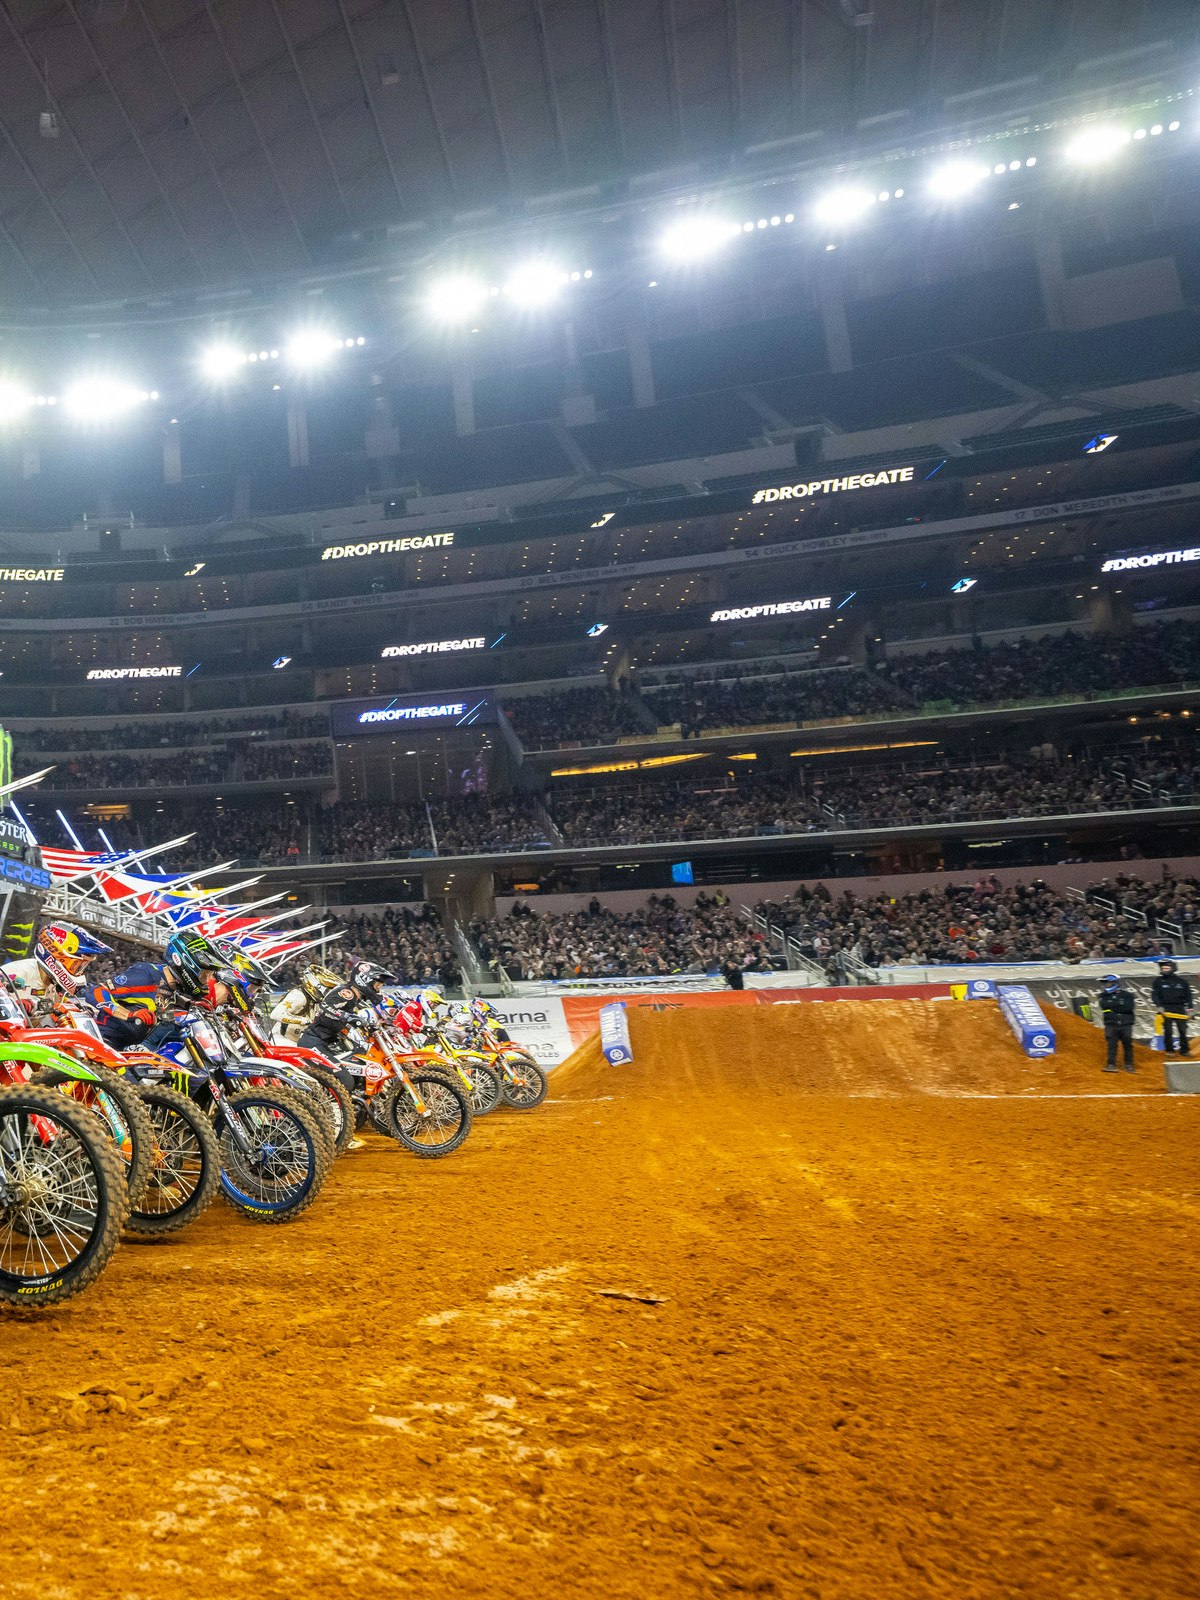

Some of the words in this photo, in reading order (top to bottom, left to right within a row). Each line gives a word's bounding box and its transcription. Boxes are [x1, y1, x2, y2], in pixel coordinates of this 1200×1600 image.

[752, 466, 914, 504] #DROPTHEGATE
[321, 533, 454, 560] #DROPTHEGATE
[710, 597, 832, 622] #DROPTHEGATE
[380, 636, 485, 657] #DROPTHEGATE
[86, 665, 182, 680] #DROPTHEGATE
[359, 703, 463, 723] #DROPTHEGATE
[17, 1278, 64, 1295] DUNLOP
